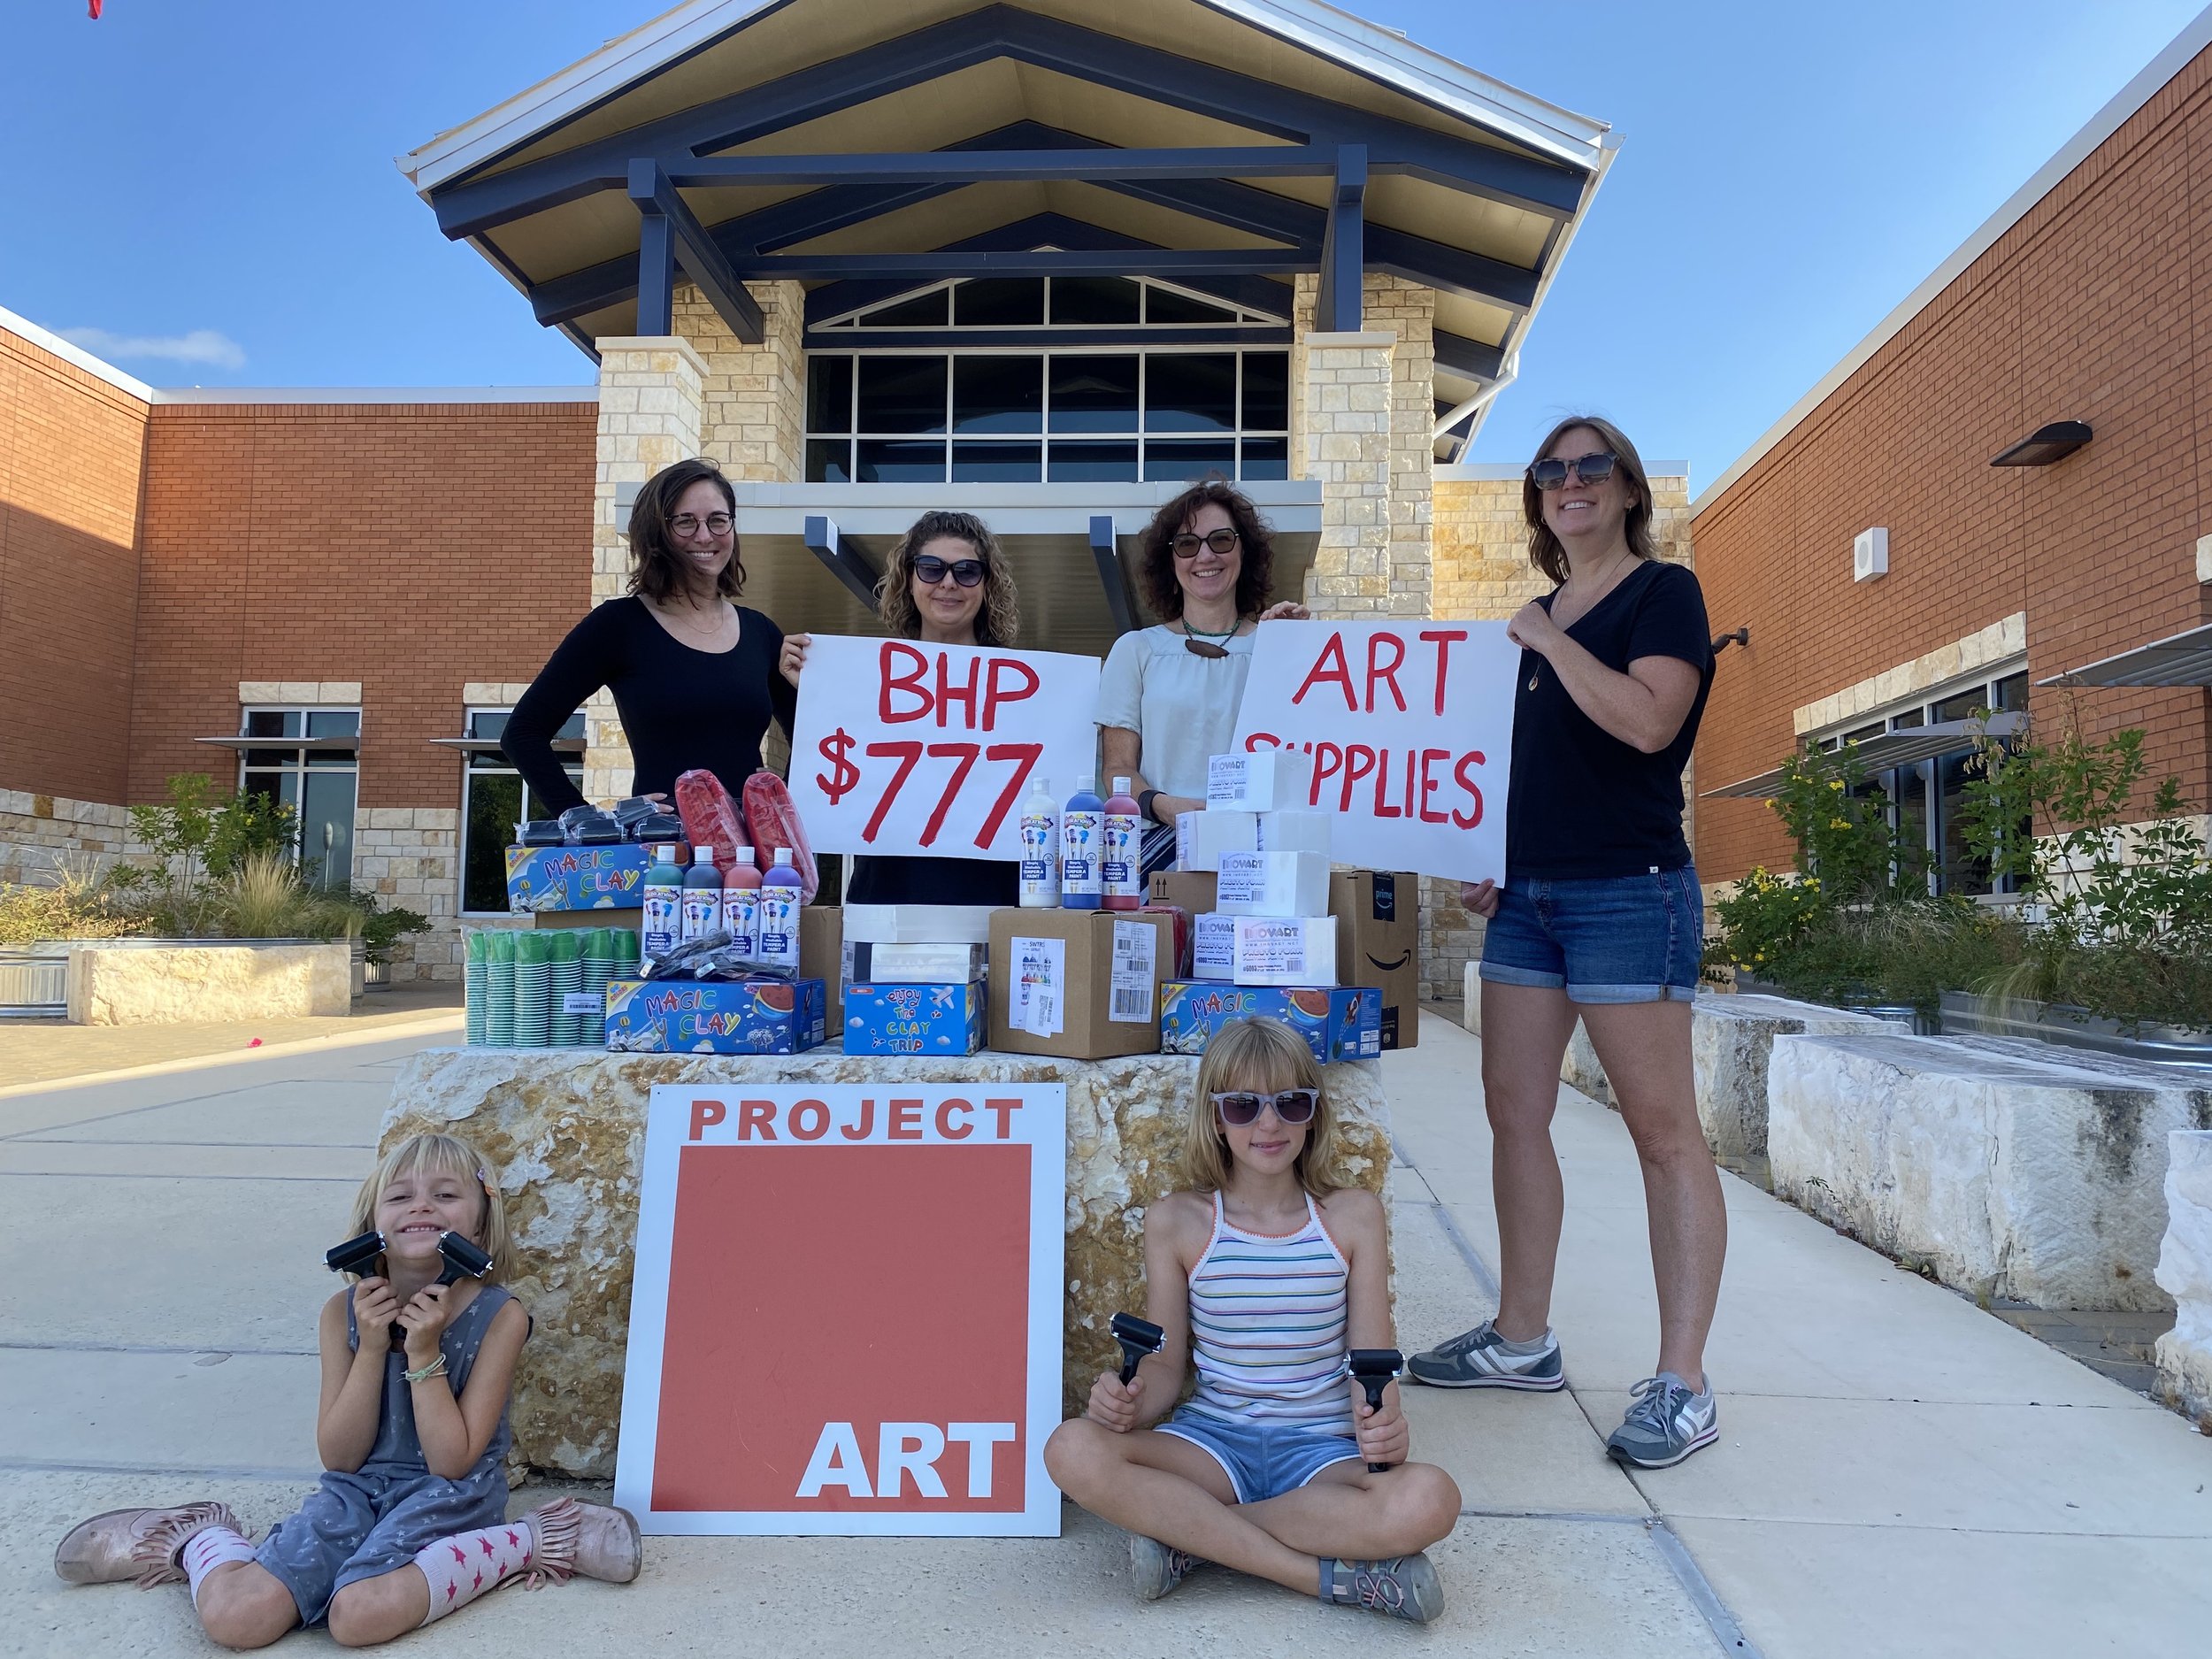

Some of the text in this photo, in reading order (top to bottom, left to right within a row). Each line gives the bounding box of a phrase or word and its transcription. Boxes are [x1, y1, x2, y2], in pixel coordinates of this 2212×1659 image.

[879, 641, 1041, 732] BHP
[1292, 630, 1468, 715] ART
[816, 727, 1043, 850] $777
[1245, 733, 1486, 830] PPLIES
[543, 849, 615, 879] MAGIC
[580, 869, 640, 892] CLAY
[1376, 888, 1393, 900] prime
[645, 989, 718, 1018] MAGIC
[886, 987, 922, 1007] enjoy
[1191, 991, 1256, 1019] MAGIC
[680, 1012, 741, 1036] CLAY
[886, 1021, 931, 1035] CLAY
[687, 1098, 1024, 1141] PROJECT
[795, 1421, 1017, 1499] ART
